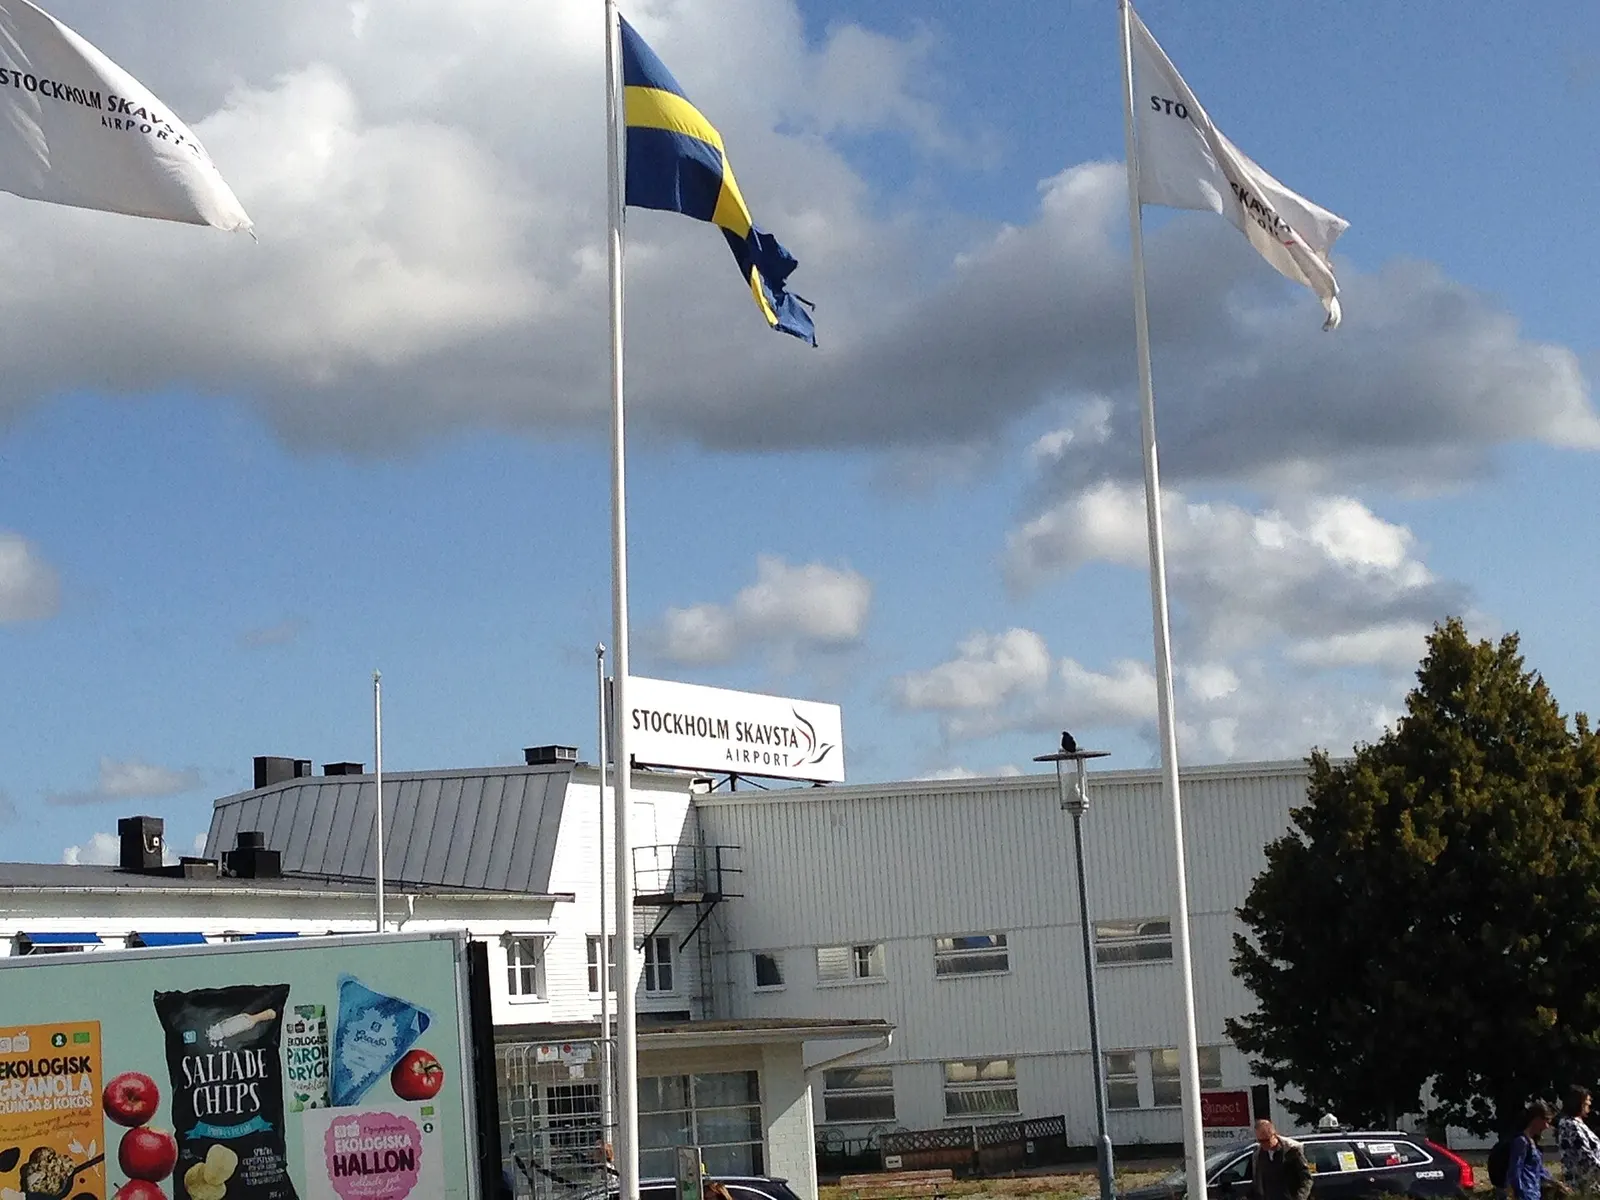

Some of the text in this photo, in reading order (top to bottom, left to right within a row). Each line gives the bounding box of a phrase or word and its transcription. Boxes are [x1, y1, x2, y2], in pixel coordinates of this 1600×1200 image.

[0, 68, 185, 141] STOCKHOLM SKAV
[631, 708, 799, 749] STOCKHOLM SKAVSTA
[725, 748, 789, 767] AIRPORT
[0, 1055, 93, 1080] EKOLOGISK
[181, 1048, 269, 1089] SALTADE
[288, 1060, 330, 1081] DRYCK
[0, 1073, 93, 1101] GRANOLA
[192, 1082, 261, 1118] CHIPS
[53, 1094, 94, 1110] KOKOS
[334, 1133, 412, 1154] EKOLOGISKA
[332, 1147, 415, 1178] HALLON
